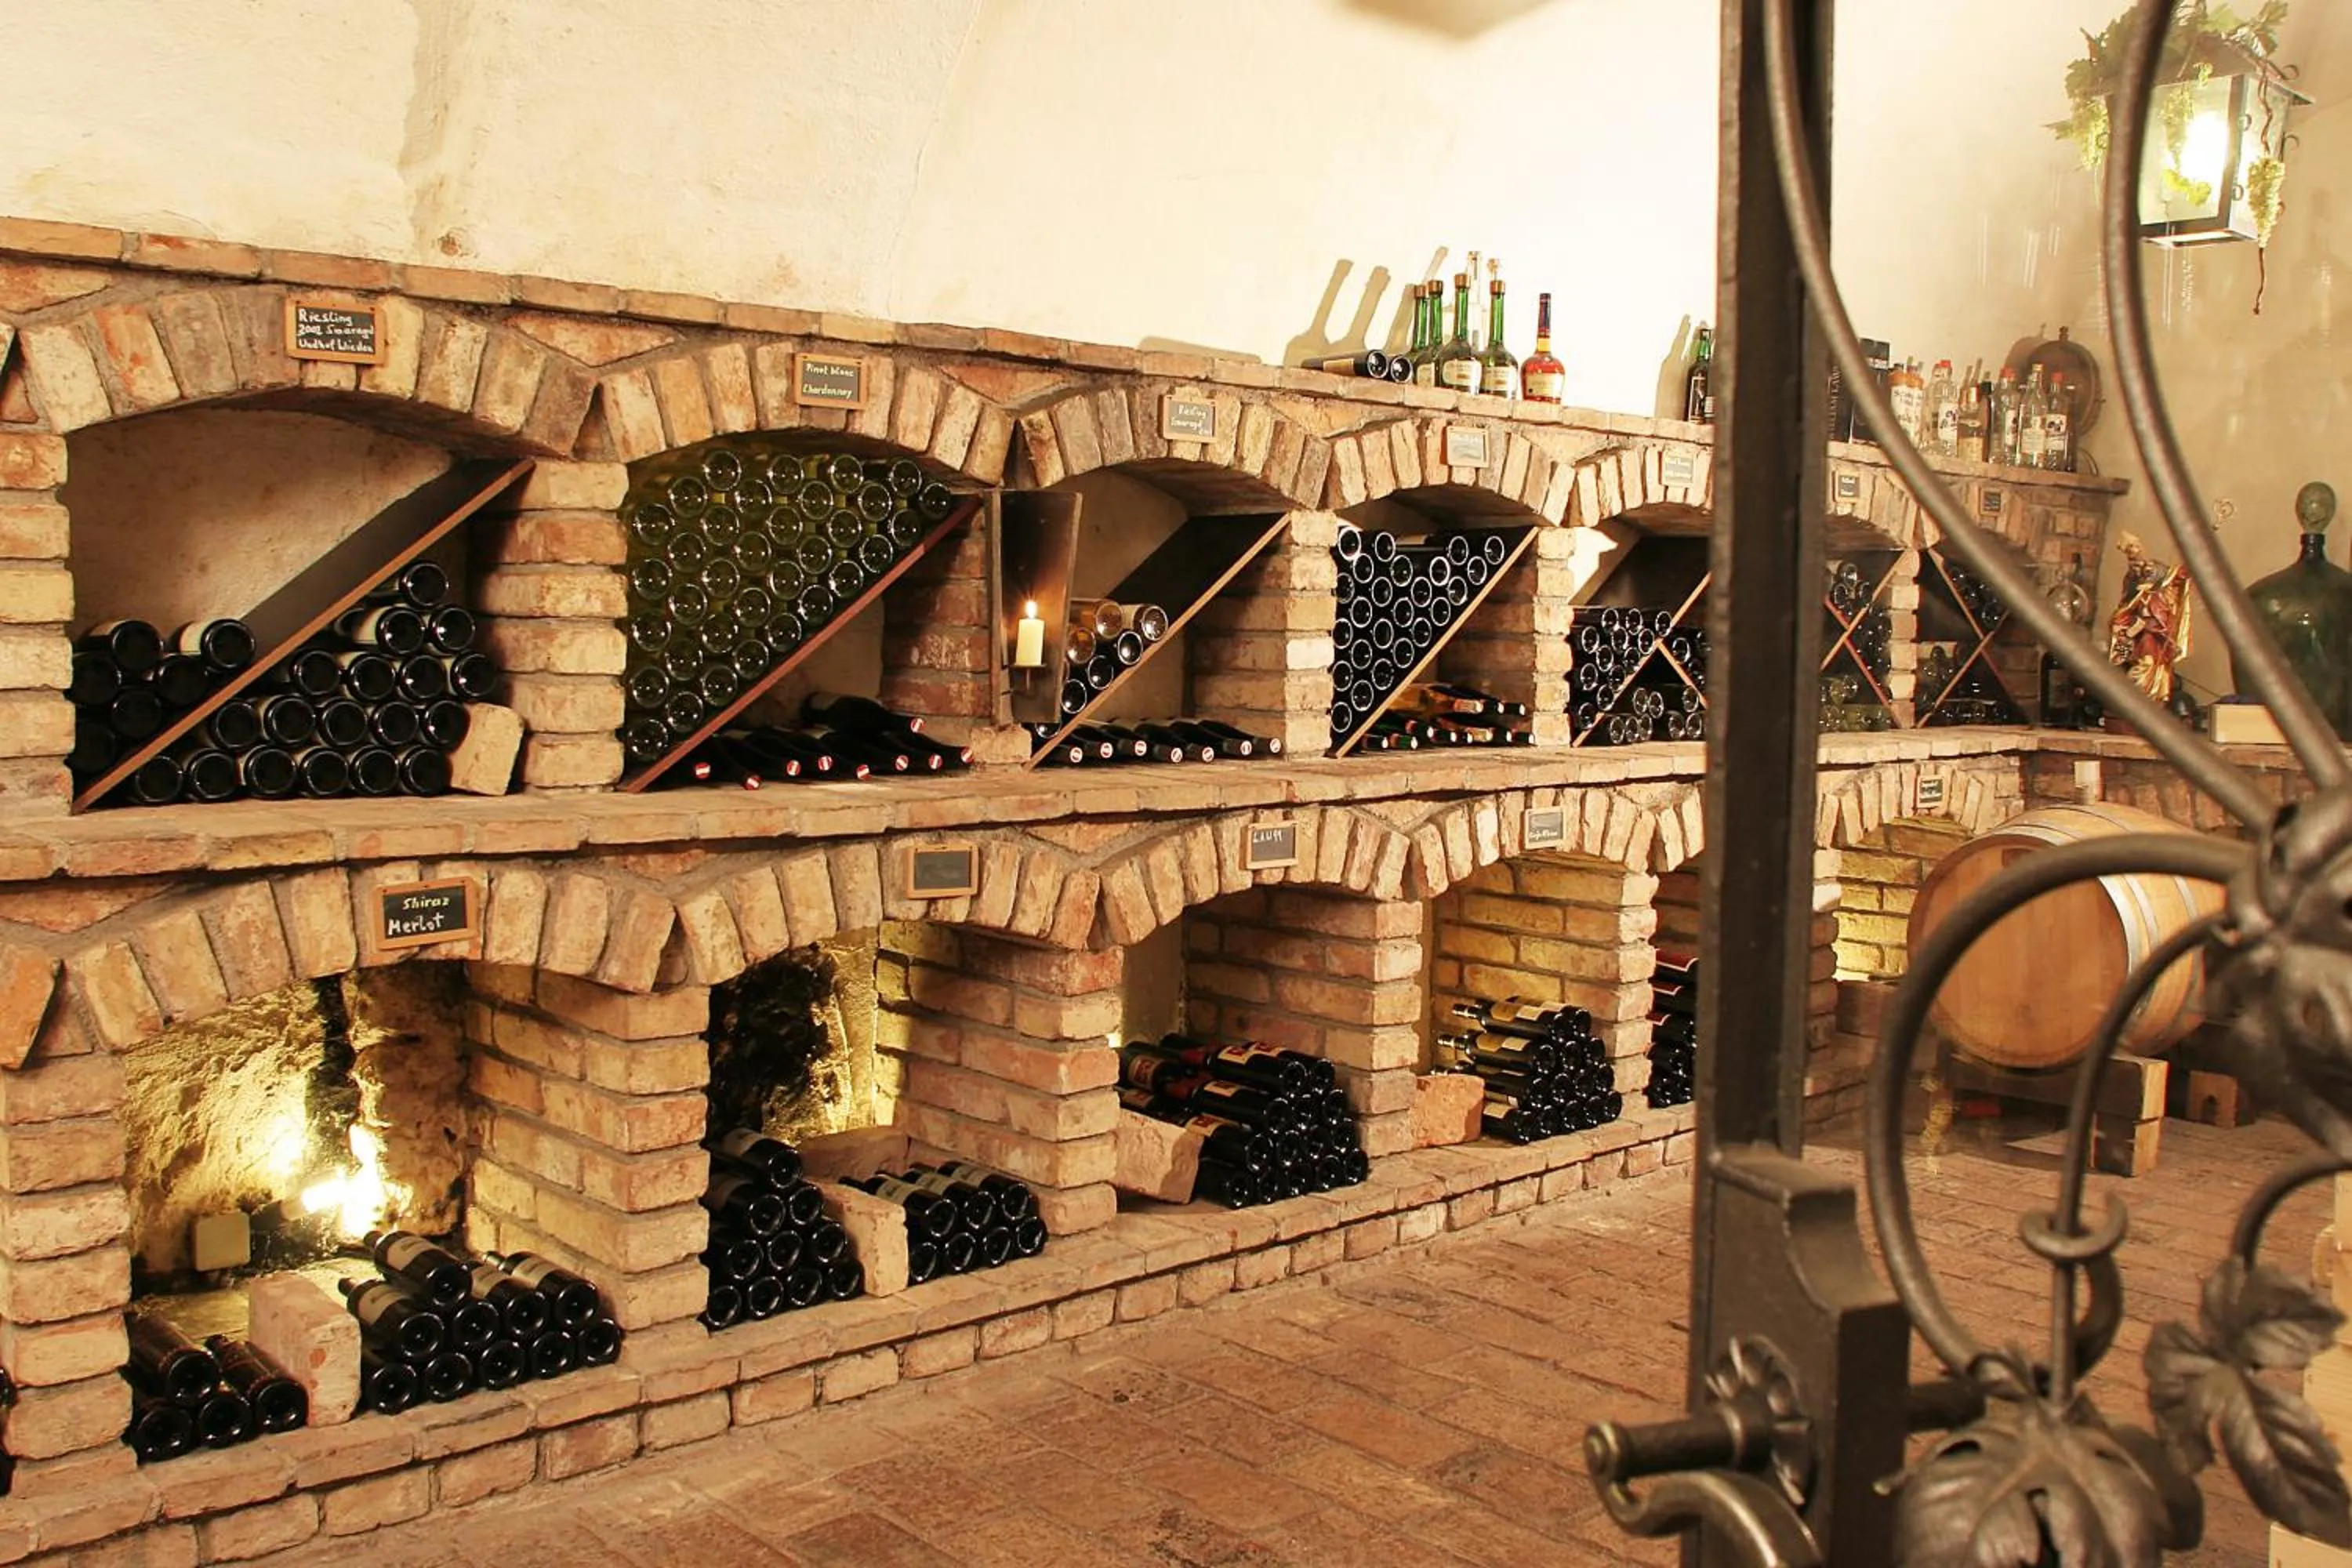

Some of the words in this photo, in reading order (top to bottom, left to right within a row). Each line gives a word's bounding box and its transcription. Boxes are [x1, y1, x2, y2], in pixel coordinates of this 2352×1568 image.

[299, 308, 352, 326] Riesling
[403, 896, 449, 910] Shiraz
[388, 912, 445, 935] Merlot
